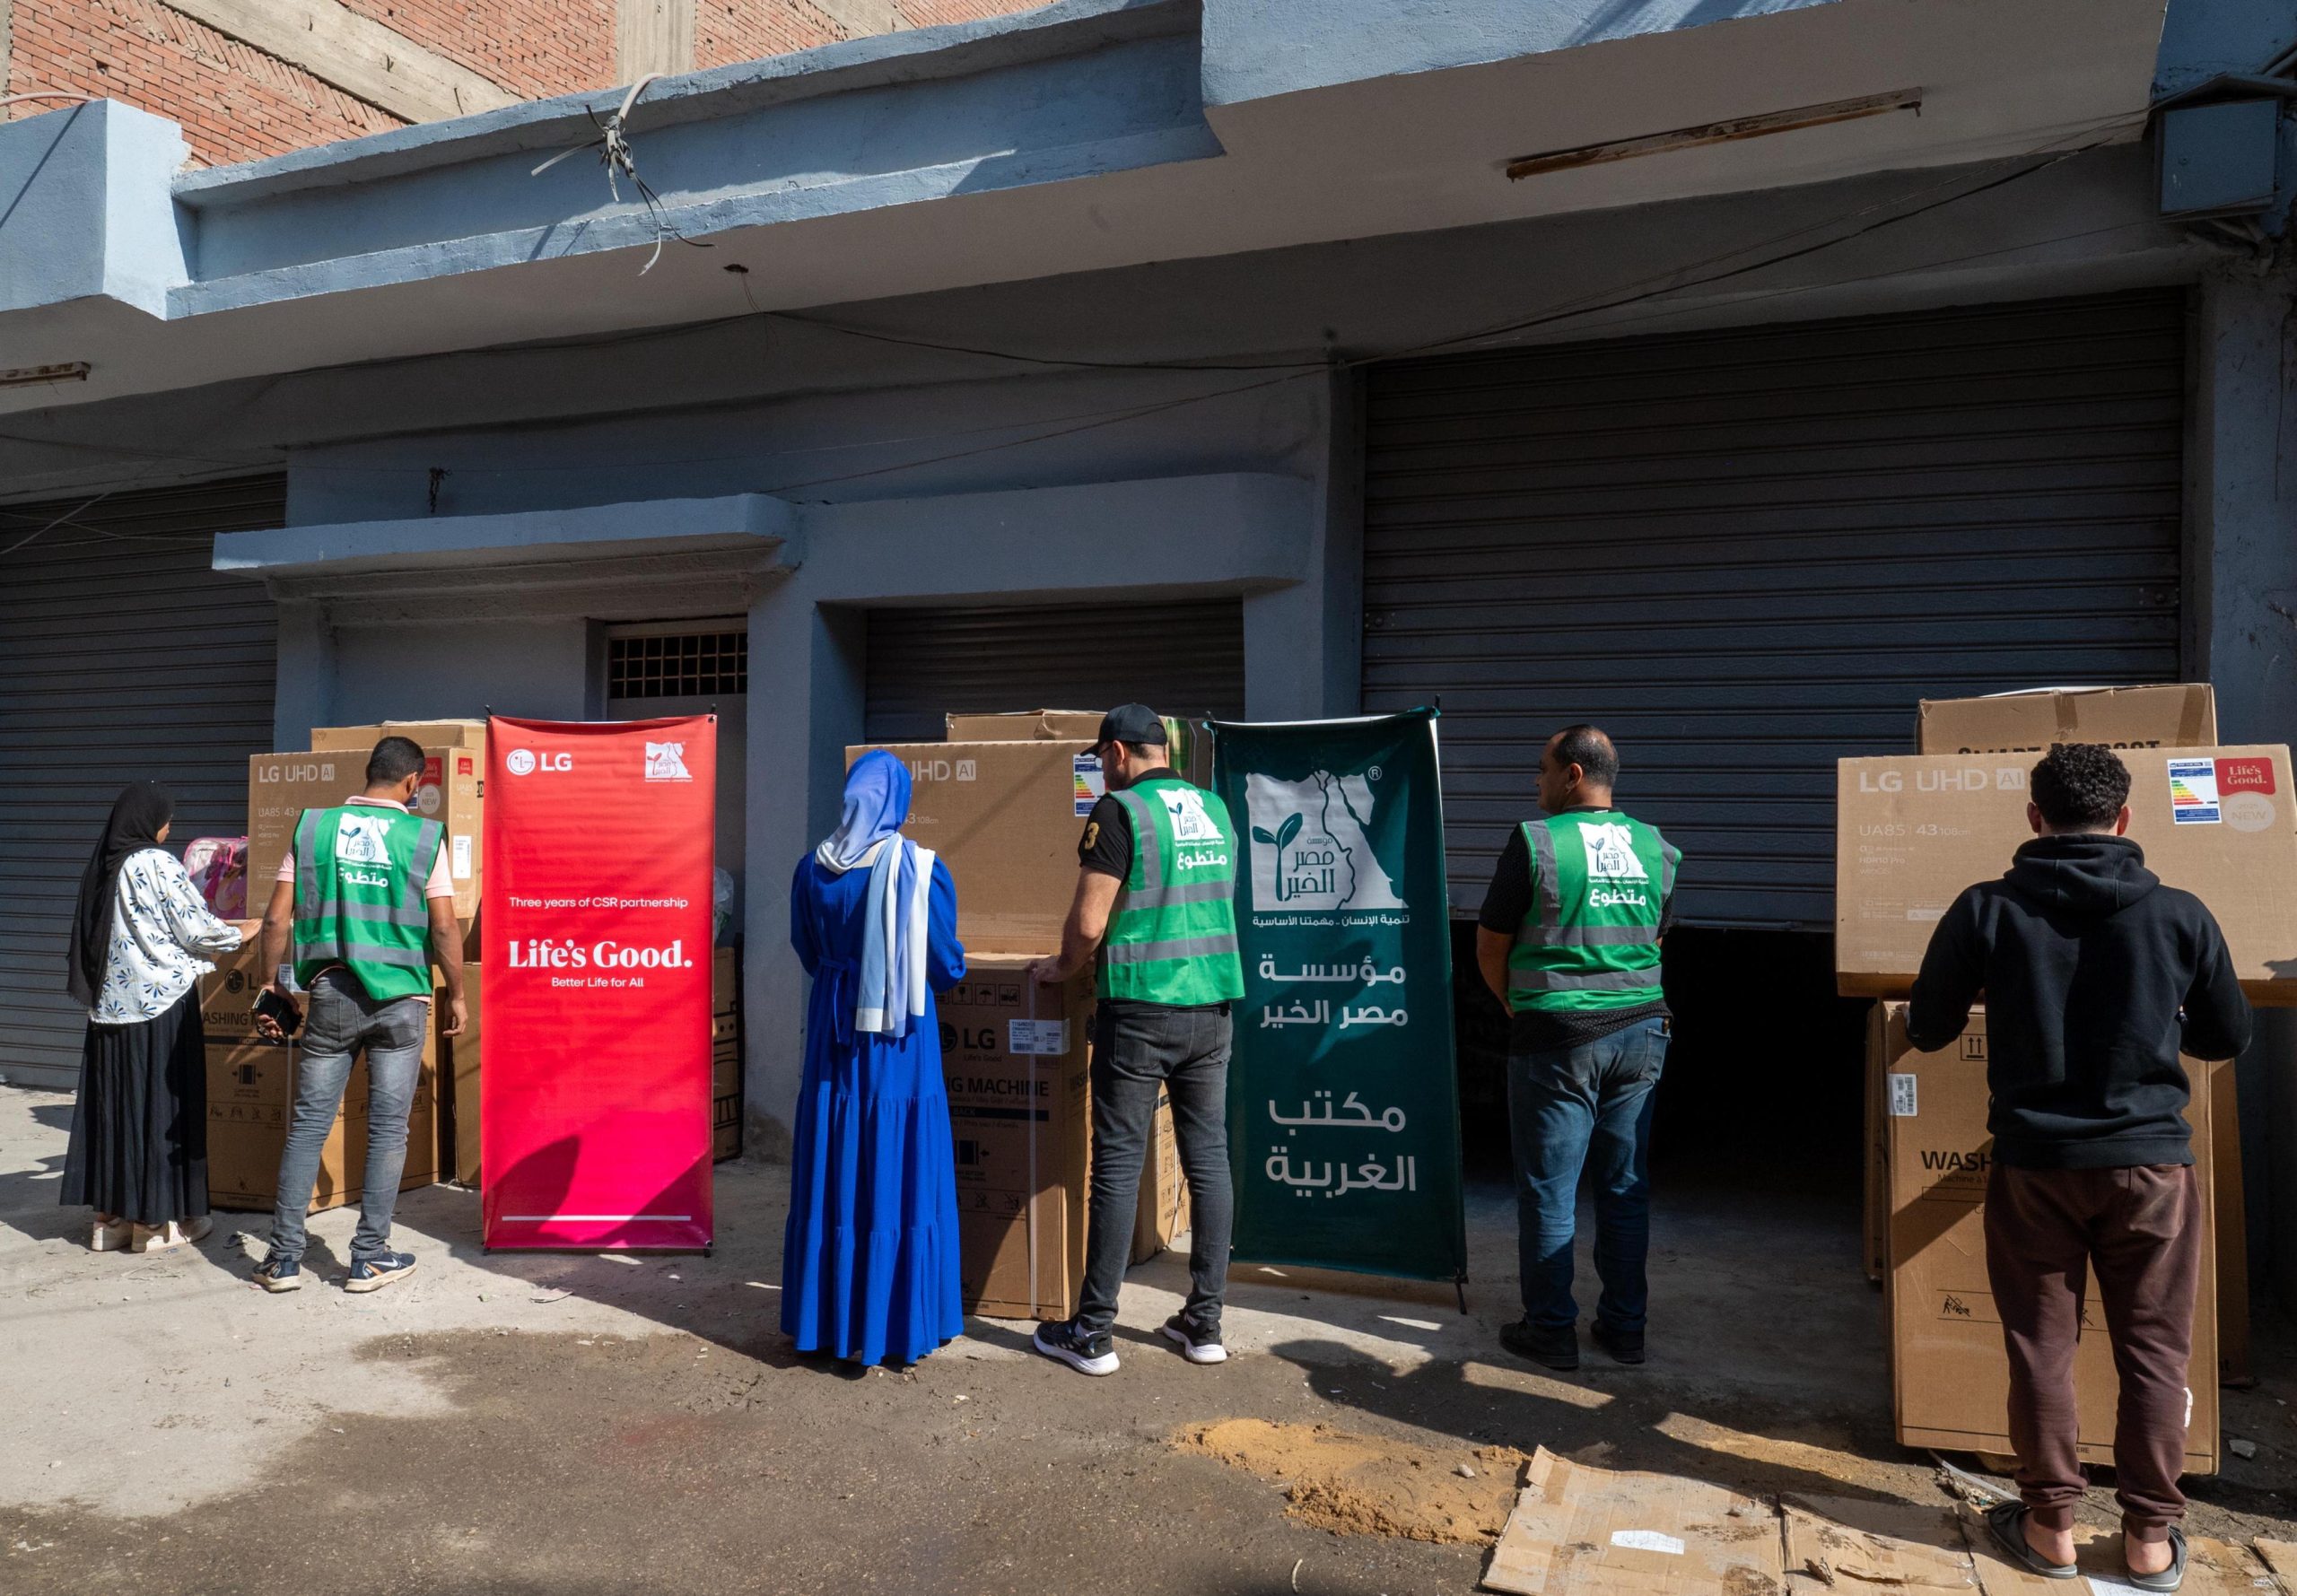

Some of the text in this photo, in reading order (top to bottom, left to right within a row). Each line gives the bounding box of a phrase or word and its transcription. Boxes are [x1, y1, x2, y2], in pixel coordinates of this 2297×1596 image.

[540, 753, 572, 772] LG
[957, 762, 975, 779] AI
[2229, 765, 2262, 776] Life's
[258, 764, 334, 783] LG UHD AI
[1859, 768, 2023, 793] LG UHD AI
[2227, 775, 2267, 785] Good.
[422, 798, 437, 806] NEW
[258, 808, 280, 817] UA85
[284, 807, 294, 817] 43
[2231, 811, 2267, 820] NEW
[1859, 824, 1906, 836] UA85
[1916, 824, 1938, 836] 43
[1177, 850, 1227, 870] متطوع
[1293, 850, 1335, 872] مصر
[1284, 868, 1335, 902] الخير
[509, 896, 688, 909] Three years of CSR partnership
[1589, 888, 1646, 907] متطوع
[1380, 913, 1411, 926] تنمية
[509, 938, 693, 968] Life's Good.
[1259, 954, 1407, 987] مؤسسة
[551, 976, 644, 988] Better Life for All
[203, 1010, 249, 1026] ASHING
[1260, 999, 1409, 1029] مصر الخير
[964, 1028, 996, 1050] LG
[967, 1077, 1049, 1096] MACHINE
[1269, 1091, 1407, 1136] مكتب
[1920, 1150, 1993, 1172] WASH
[1265, 1146, 1417, 1199] الغربية
[1937, 1173, 1974, 1183] Machine
